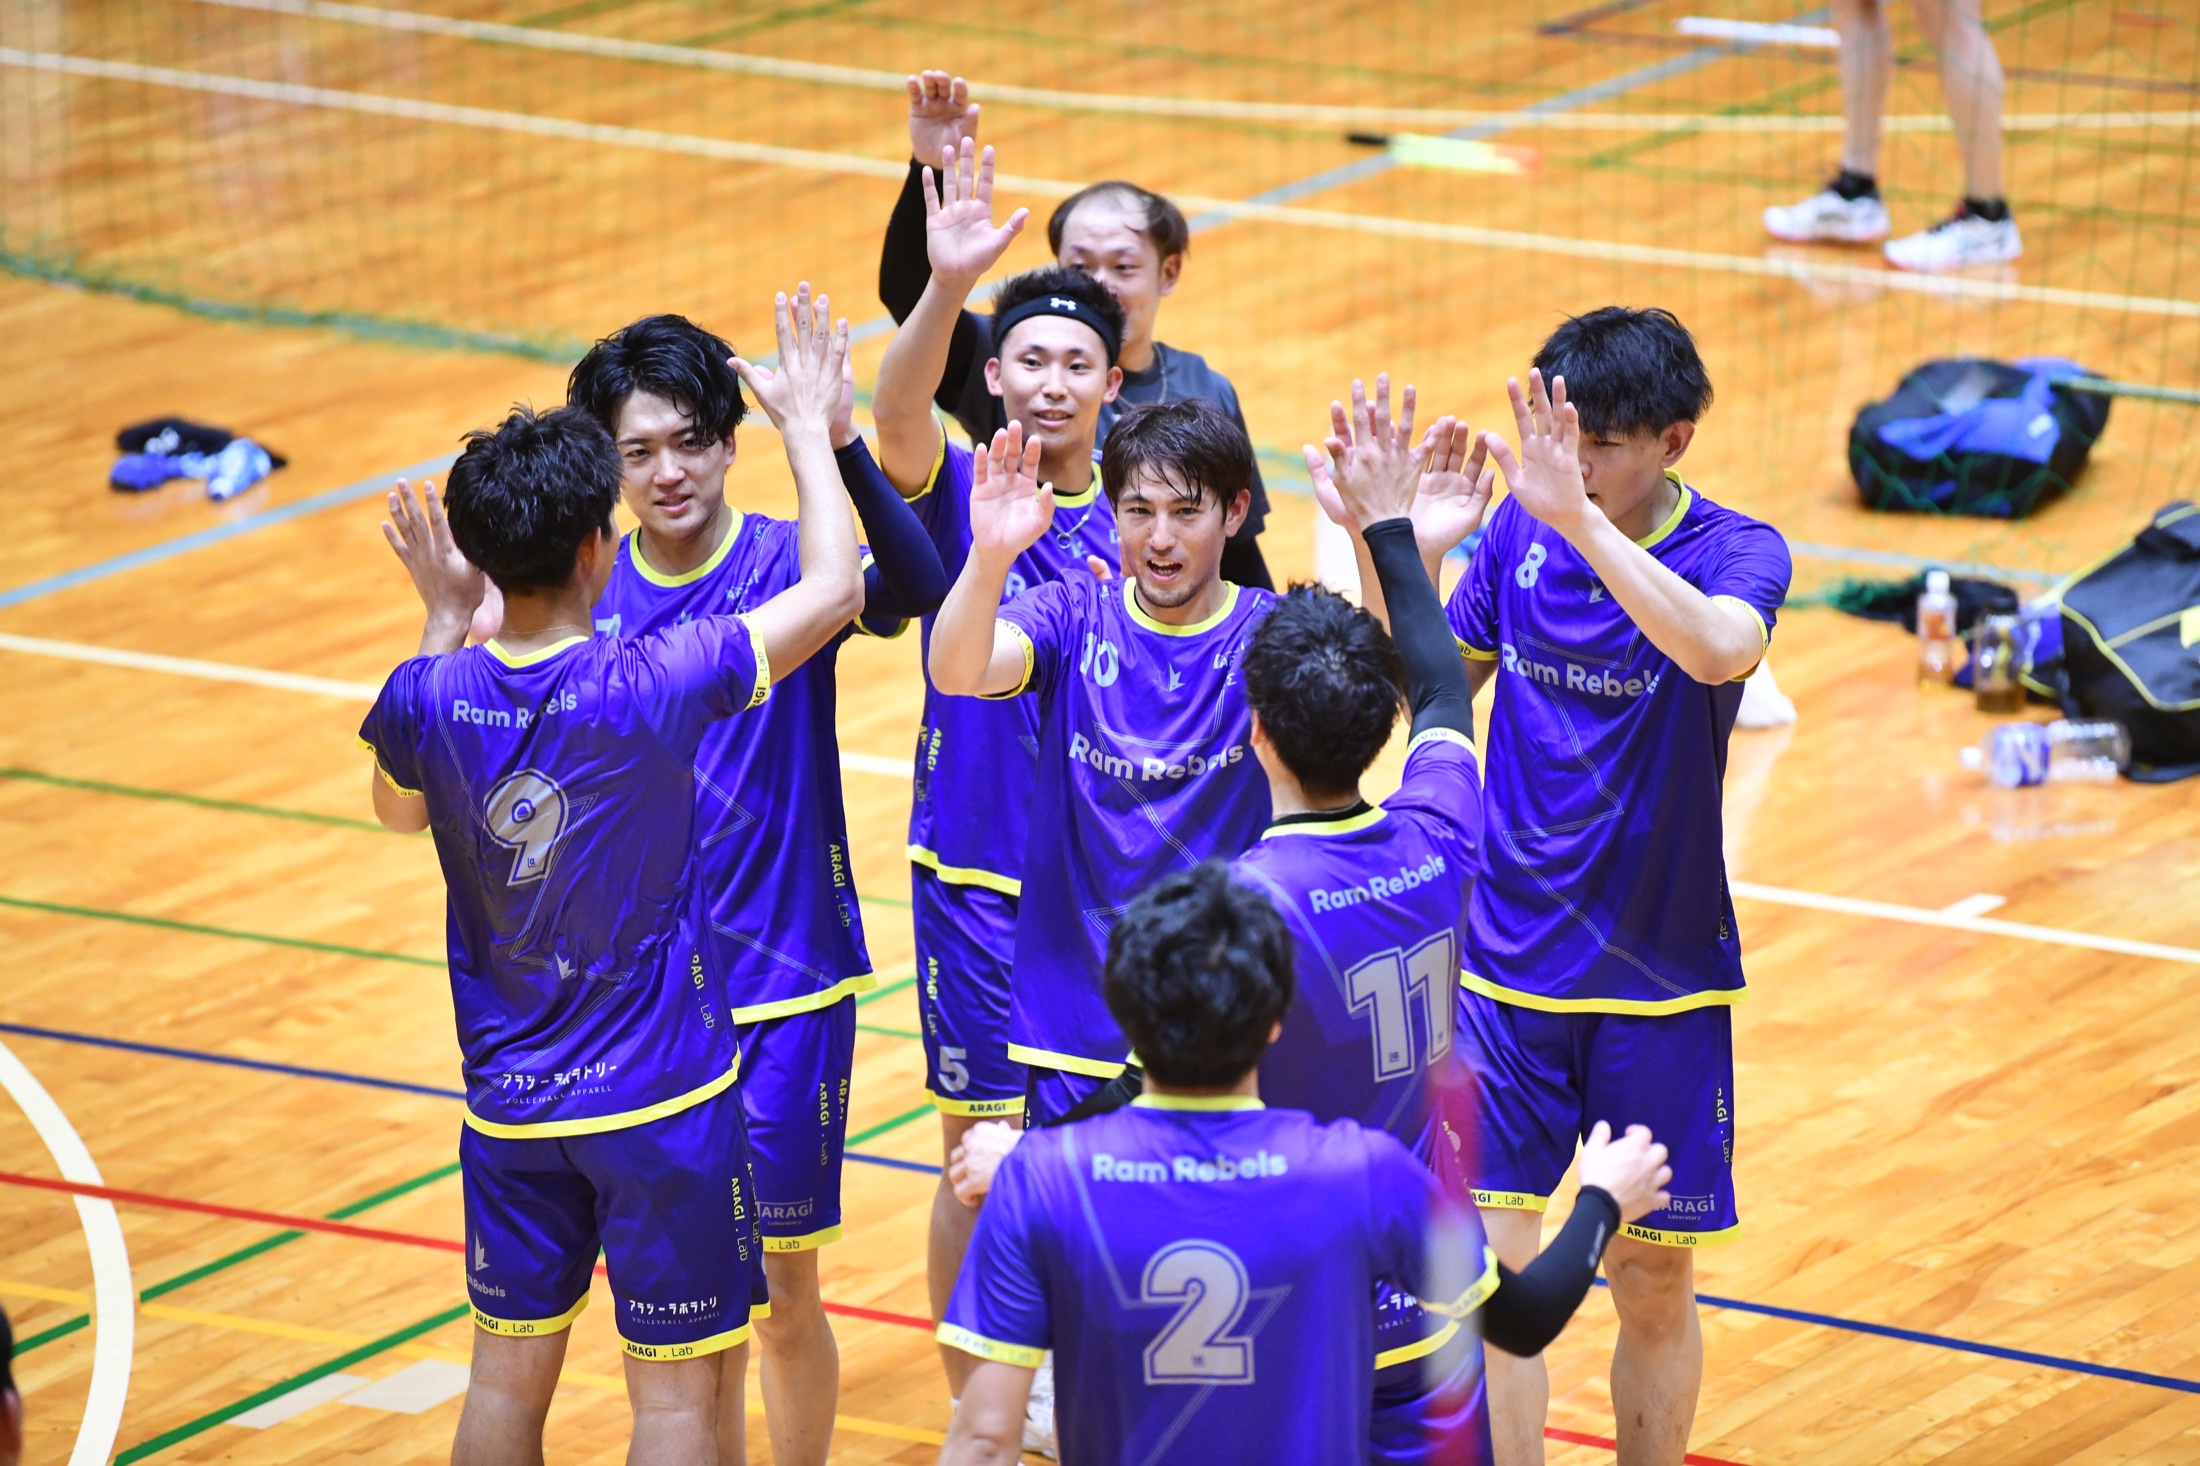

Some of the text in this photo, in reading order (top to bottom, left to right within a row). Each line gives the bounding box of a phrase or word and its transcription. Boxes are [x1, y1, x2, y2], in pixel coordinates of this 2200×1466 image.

[1515, 542, 1547, 589] 8
[1080, 631, 1119, 687] 10
[1501, 642, 1559, 686] Ram
[452, 699, 511, 728] Ram
[1069, 731, 1133, 780] Ram
[483, 767, 569, 887] 9
[829, 844, 852, 928] ARAGI Lab
[1309, 854, 1446, 914] Ram Rebels
[700, 1003, 715, 1029] Lab
[1344, 926, 1456, 1082] 11
[571, 1084, 613, 1097] APPAREL
[938, 1045, 970, 1093] 5
[820, 1082, 830, 1126] ARAGI
[968, 1103, 1006, 1113] ARAGI
[1091, 1150, 1288, 1184] Ram Rebels
[732, 1177, 749, 1262] ARAGI Lab
[1505, 1195, 1524, 1206] Lab
[778, 1240, 800, 1250] Lab
[1626, 1226, 1697, 1245] ARAGI Lab
[475, 1311, 534, 1333] ARAGI Lab
[632, 1311, 720, 1325] VOLLEYBALL APPAREL
[1141, 1238, 1255, 1385] 2
[626, 1342, 693, 1358] ARAGI Lab
